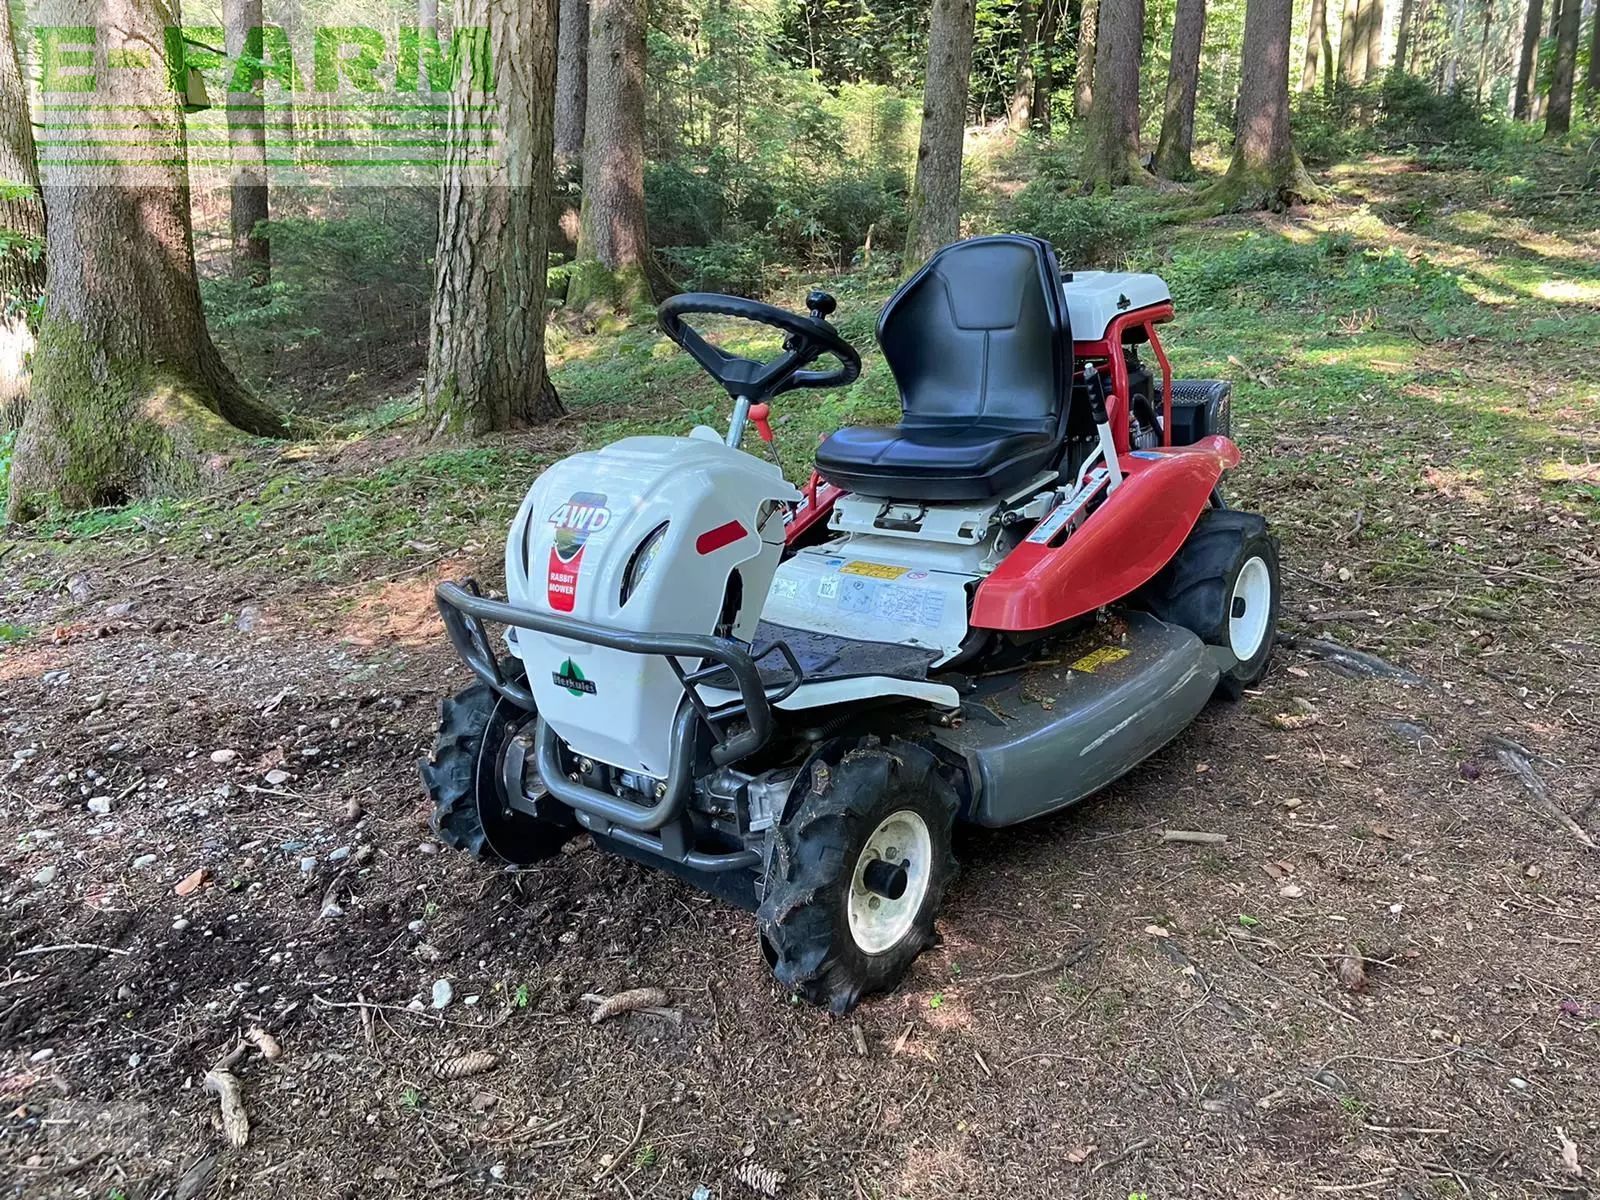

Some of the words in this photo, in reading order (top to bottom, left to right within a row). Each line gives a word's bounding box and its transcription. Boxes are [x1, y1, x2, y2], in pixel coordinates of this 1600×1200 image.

[549, 503, 611, 533] 4WD
[550, 573, 574, 583] RABBIT
[549, 584, 574, 595] MOWER
[553, 674, 594, 692] Herkules
